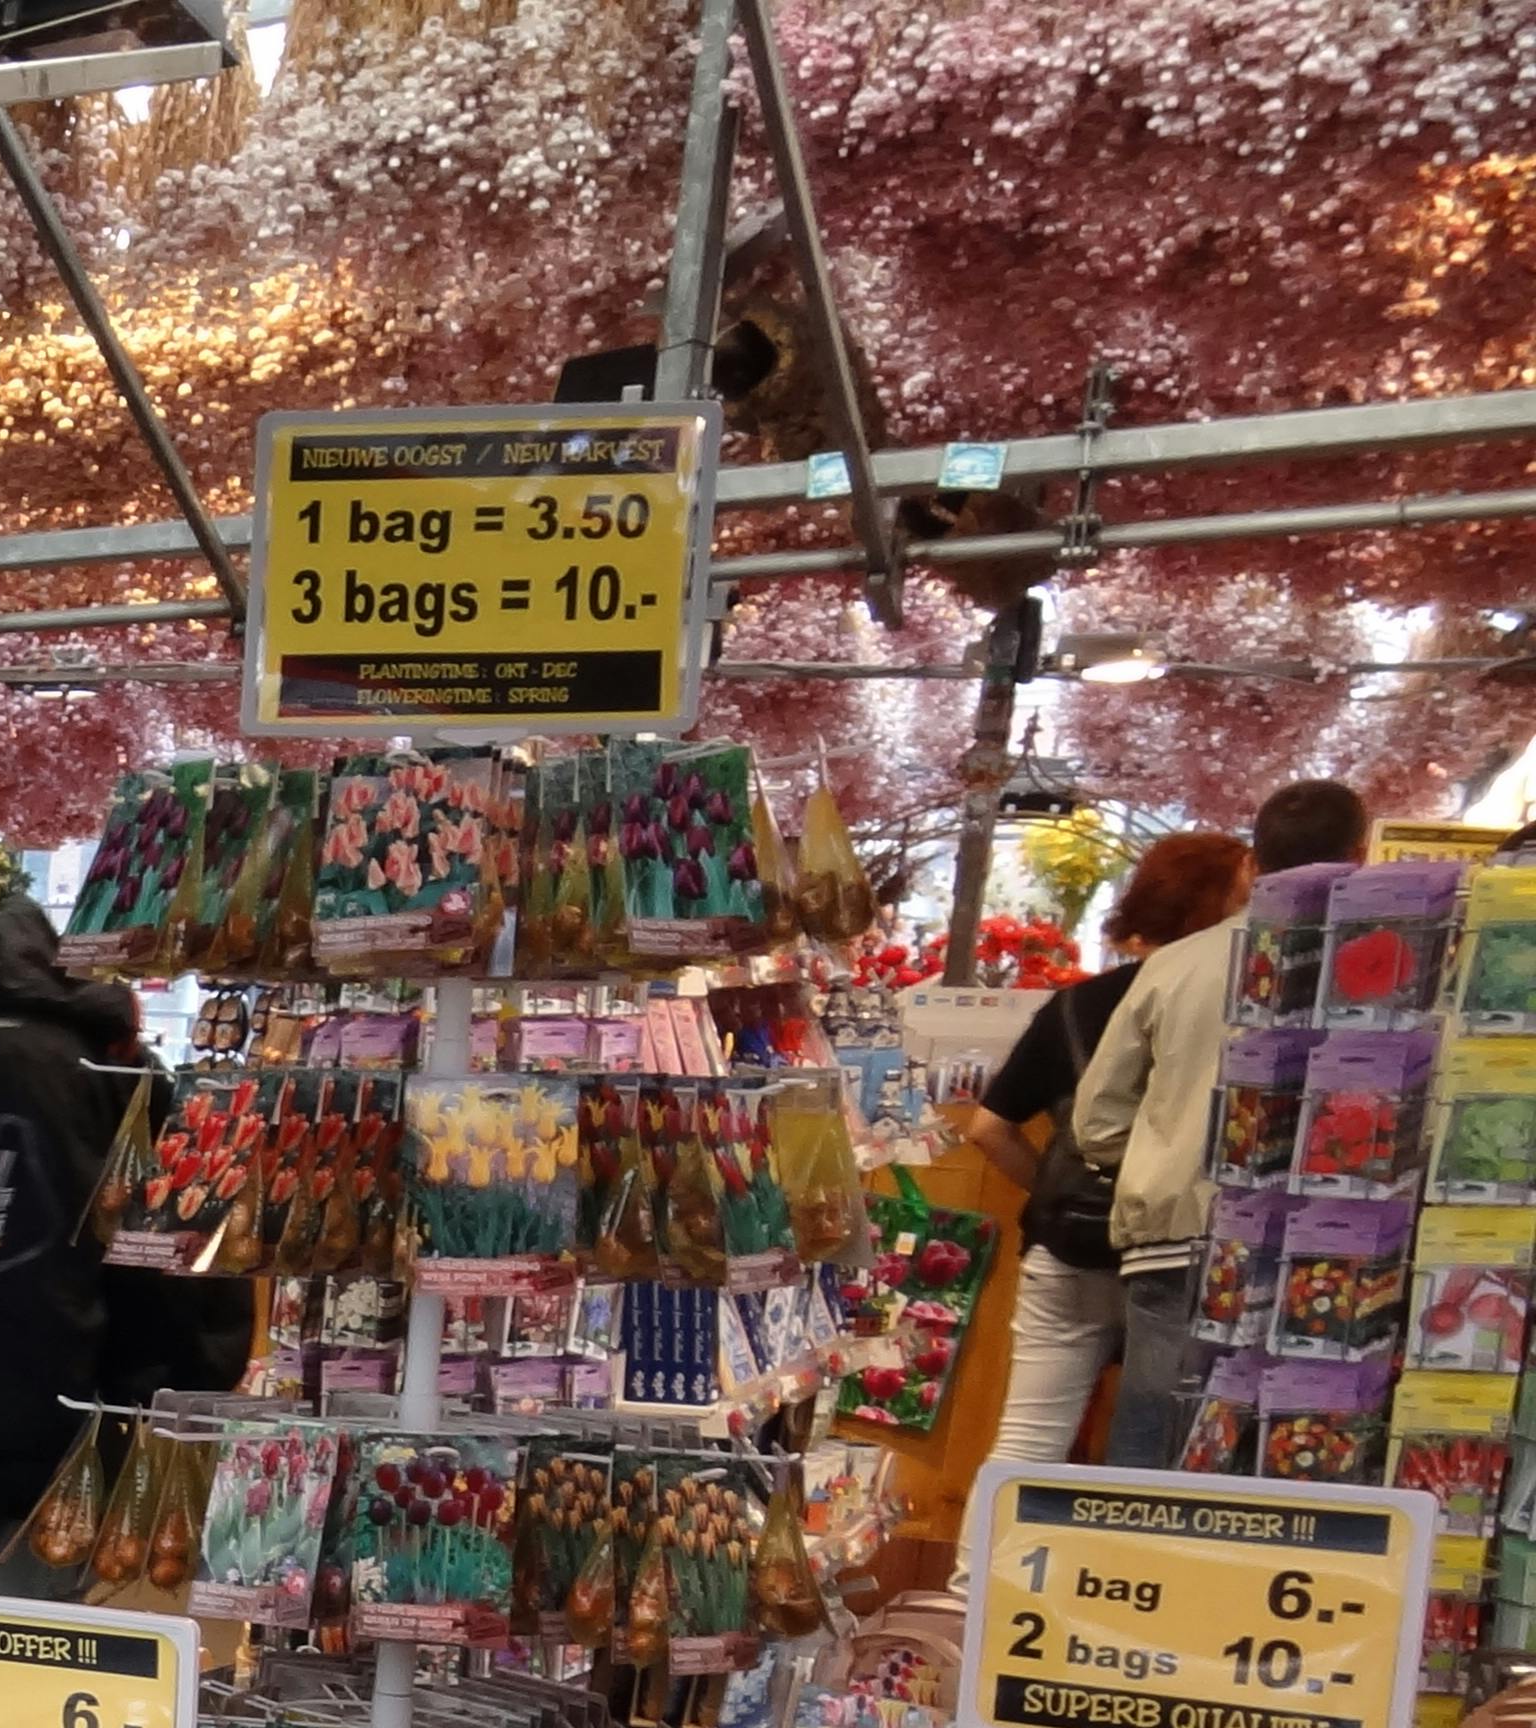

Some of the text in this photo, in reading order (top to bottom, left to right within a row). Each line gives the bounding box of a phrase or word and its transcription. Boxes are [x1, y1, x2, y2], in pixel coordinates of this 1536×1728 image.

[301, 439, 666, 469] NIEUWE OOGST NEW HARVEST
[297, 493, 651, 553] 1 bag = 3.50
[292, 565, 658, 637] 3 bags = 10.-
[495, 664, 529, 679] OKT
[542, 662, 577, 679] DEC
[508, 687, 569, 703] SPRING
[1072, 1498, 1315, 1541] SPECIAL OFFER !!!
[1020, 1545, 1366, 1624] 1 bag 6.-
[78, 1639, 98, 1664] !!!
[1007, 1611, 1354, 1694] 2 bags 10.-
[1023, 1685, 1160, 1728] SUPERB
